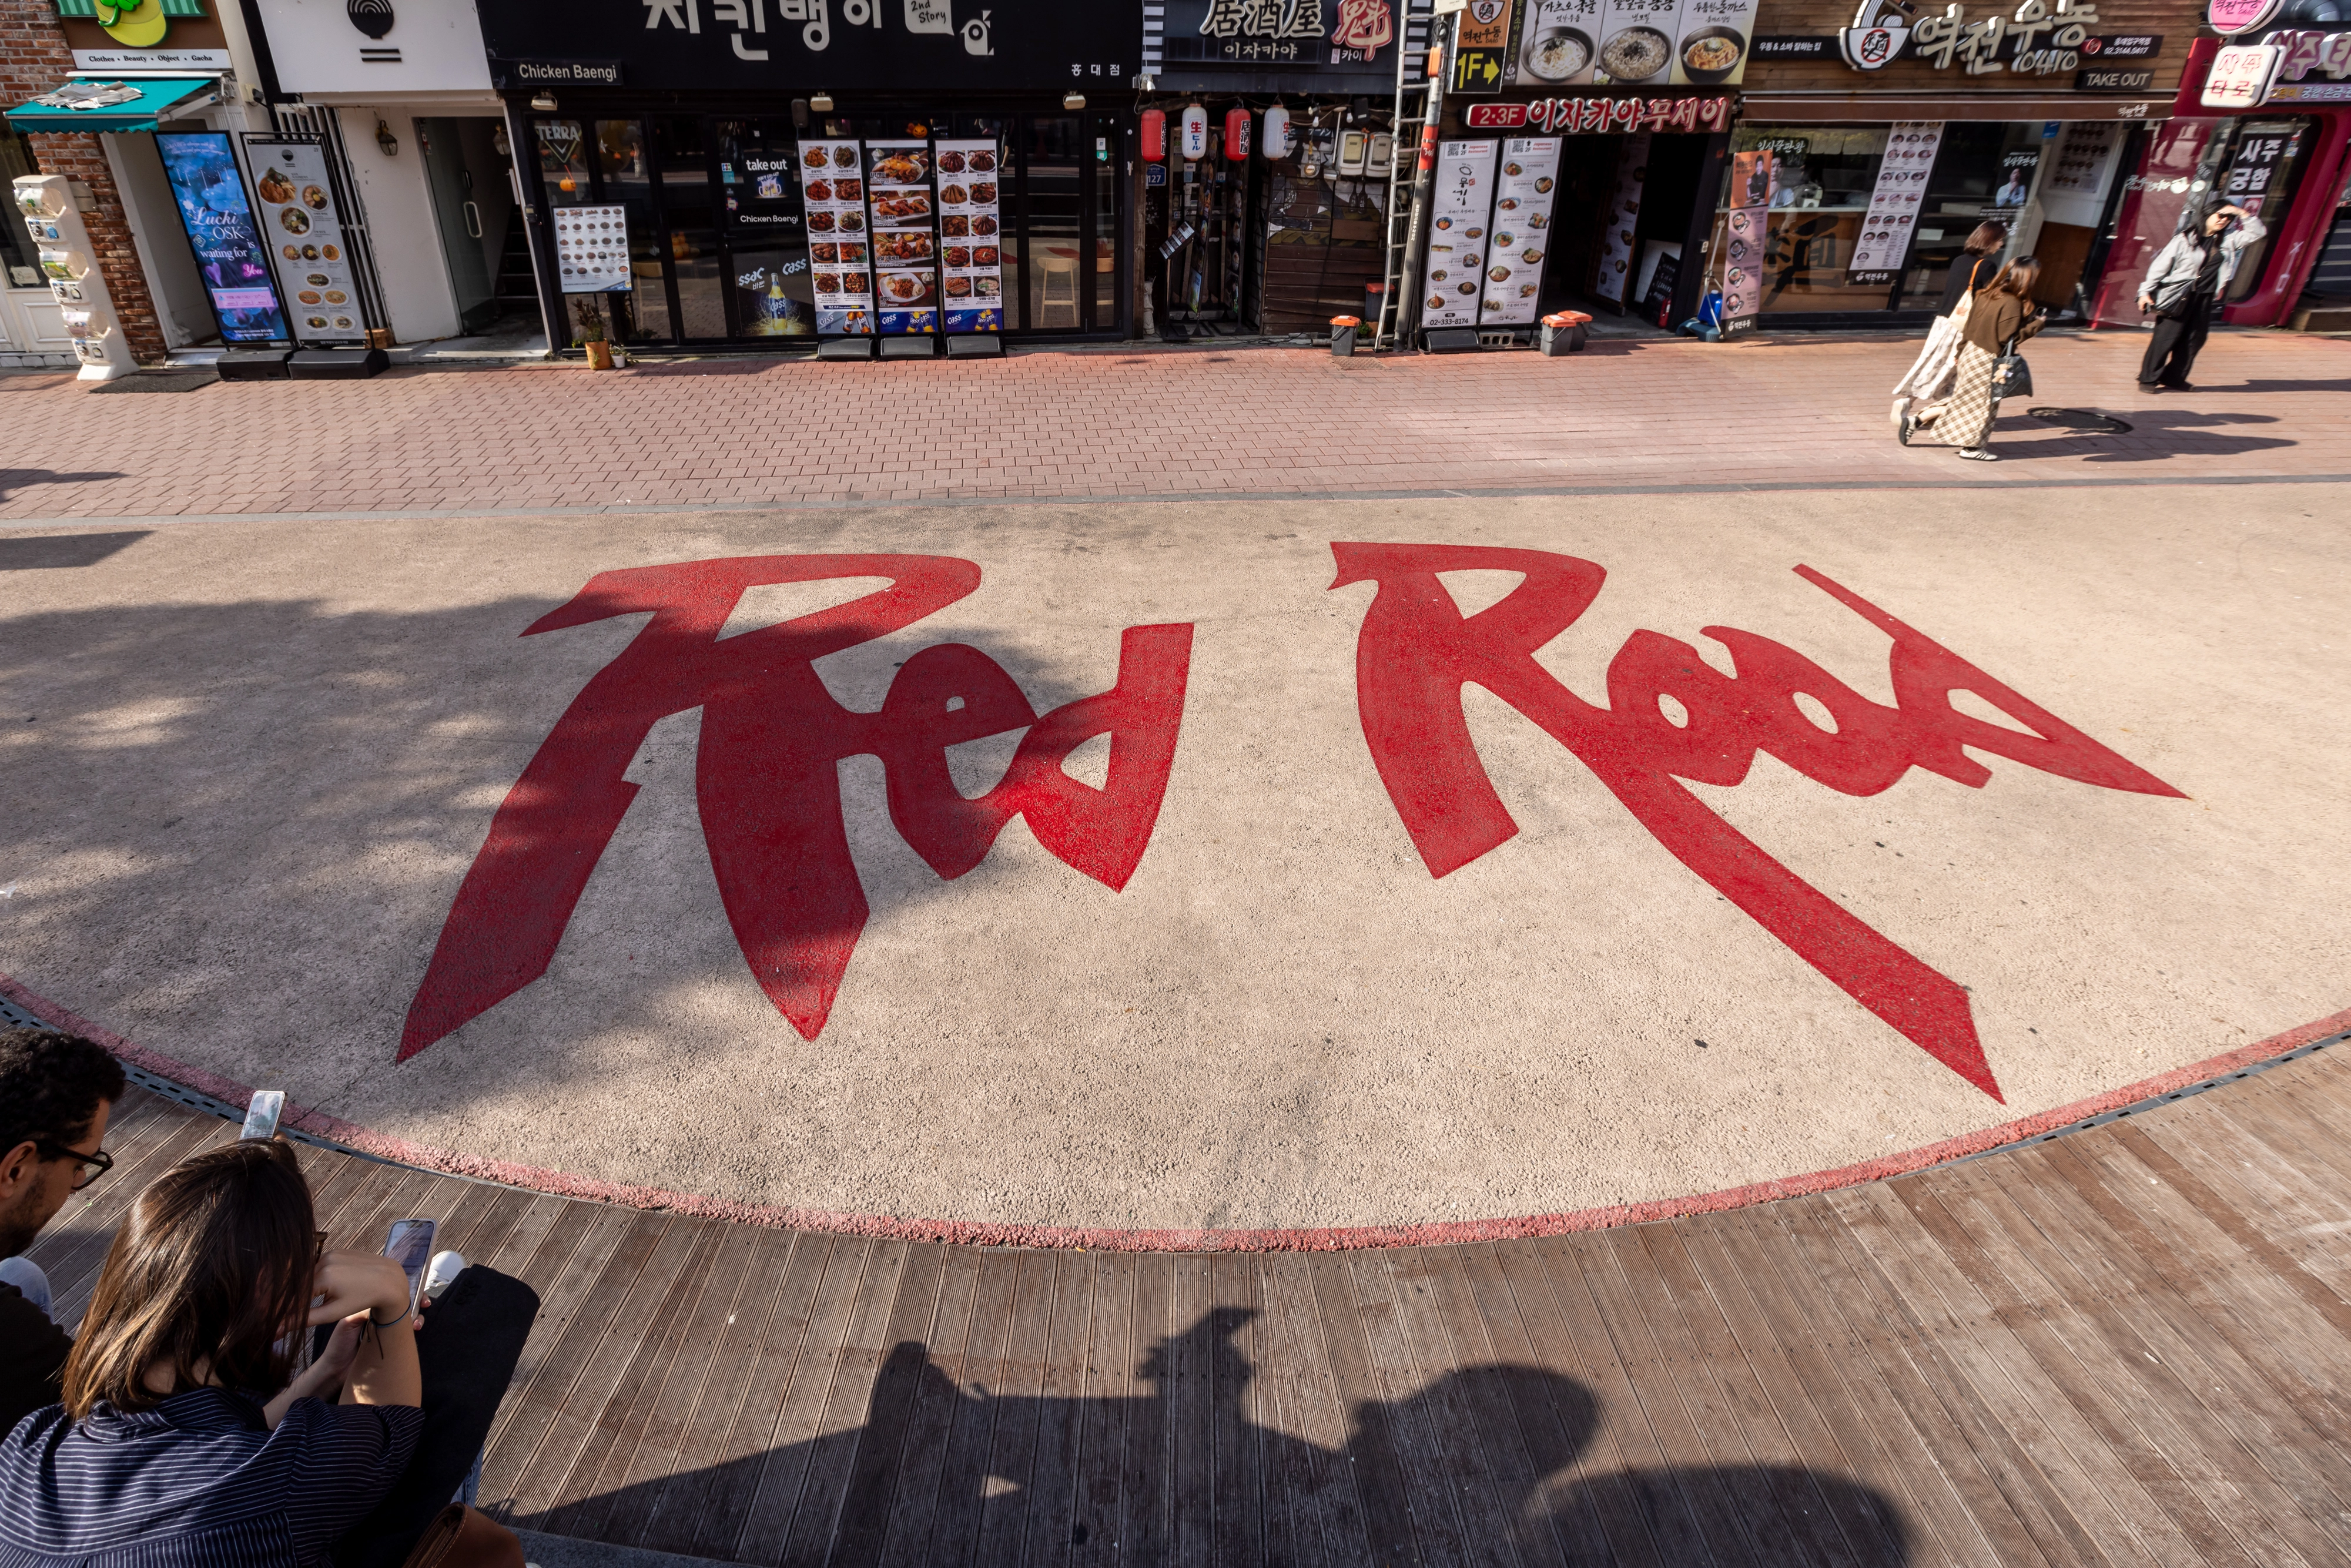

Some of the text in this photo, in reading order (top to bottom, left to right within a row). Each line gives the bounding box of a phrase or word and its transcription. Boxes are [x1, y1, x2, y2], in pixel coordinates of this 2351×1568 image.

[910, 0, 931, 12] 2nd
[918, 5, 947, 25] Story
[1513, 16, 1522, 32] 소바
[1463, 26, 1502, 44] 역전우동
[1912, 0, 2099, 75] 역전우동
[1224, 42, 1298, 60] 이자카야
[1759, 41, 1822, 52] 우동 & 소바 잘하는 집
[158, 55, 179, 63] Object
[1341, 49, 1362, 62] 카이
[2011, 49, 2079, 76] 0410
[2217, 53, 2263, 74] 사주
[519, 64, 617, 83] Chicken Baengi
[1458, 53, 1484, 89] 1F
[2087, 72, 2151, 87] TAKE OUT
[2211, 80, 2250, 98] 타로
[1529, 97, 1730, 133] 이자카야 무세이
[538, 125, 581, 142] TERRA
[1757, 139, 1806, 154] 일식끝판왕
[2238, 139, 2283, 163] 사주
[746, 158, 788, 171] take out
[1147, 175, 1161, 183] 127
[2229, 167, 2271, 191] 궁합
[1452, 177, 1469, 206] 무세이
[190, 207, 239, 226] Lucki
[773, 215, 798, 225] Baengi
[213, 226, 245, 240] OSK
[247, 239, 255, 249] is
[200, 246, 247, 261] waiting for
[243, 264, 263, 277] You
[782, 258, 807, 276] Cass
[771, 300, 786, 312] Cass
[819, 314, 834, 326] Cass
[882, 313, 897, 324] Cass
[947, 313, 962, 324] Cass
[397, 542, 2186, 1105] Red Road
